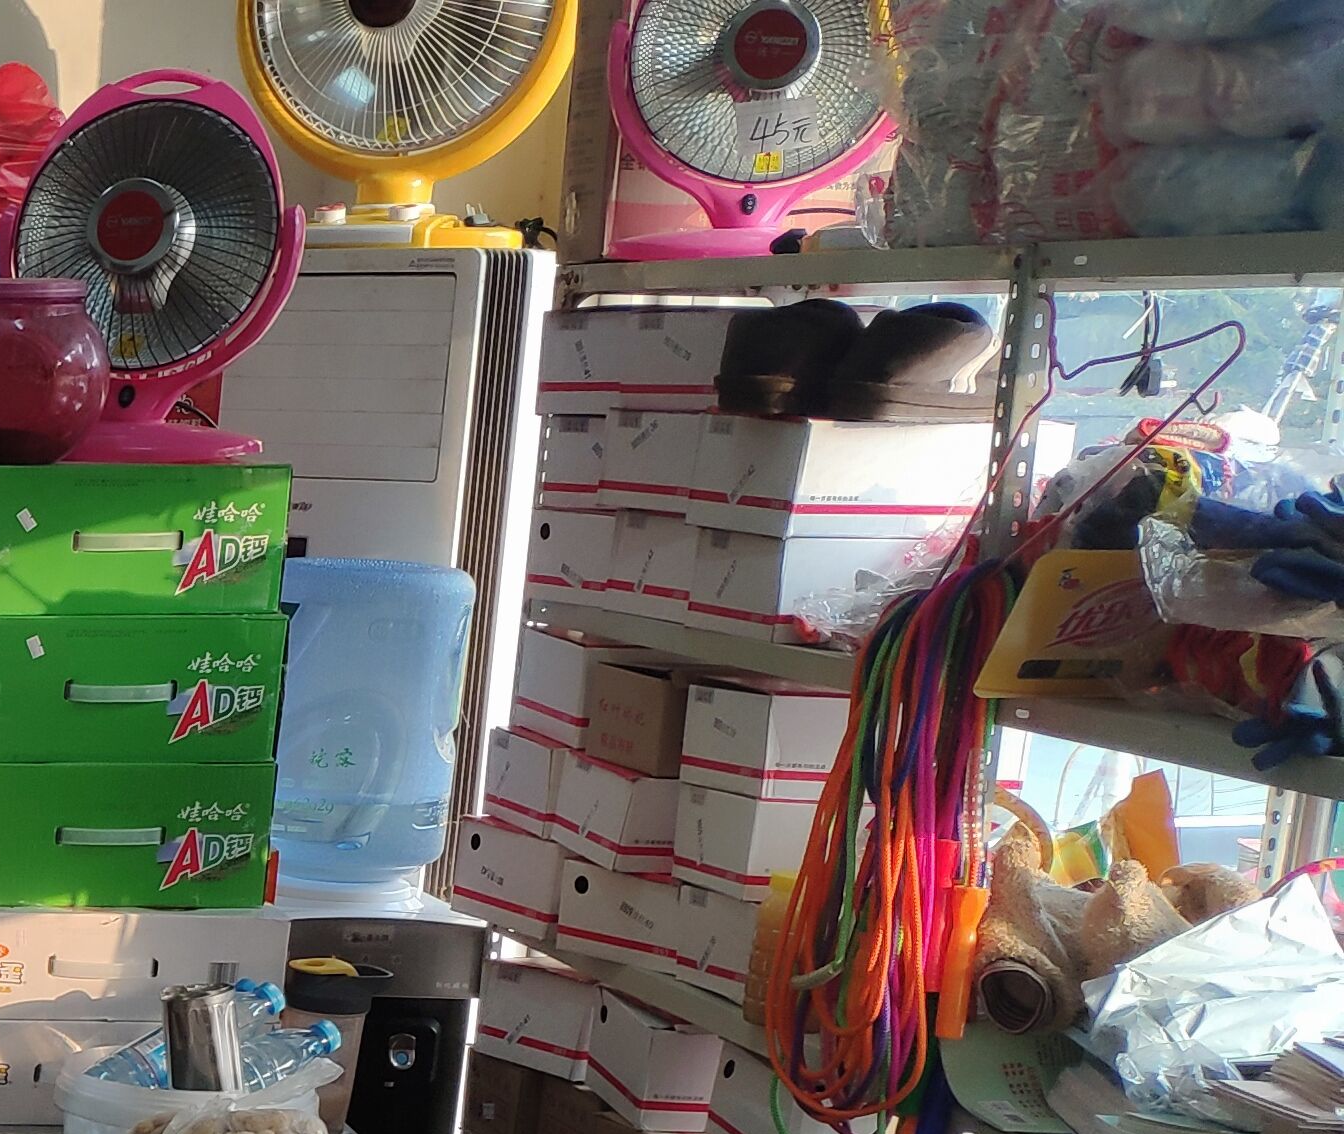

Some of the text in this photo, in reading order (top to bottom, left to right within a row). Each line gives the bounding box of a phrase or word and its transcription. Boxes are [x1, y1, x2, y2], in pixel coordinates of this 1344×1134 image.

[749, 112, 812, 146] 45元
[193, 501, 263, 523] 娃哈哈
[174, 528, 270, 597] AD钙
[187, 652, 258, 674] 娃哈哈
[168, 679, 265, 745] AD钙
[177, 801, 248, 822] 娃哈哈
[158, 827, 255, 891] AD钙
